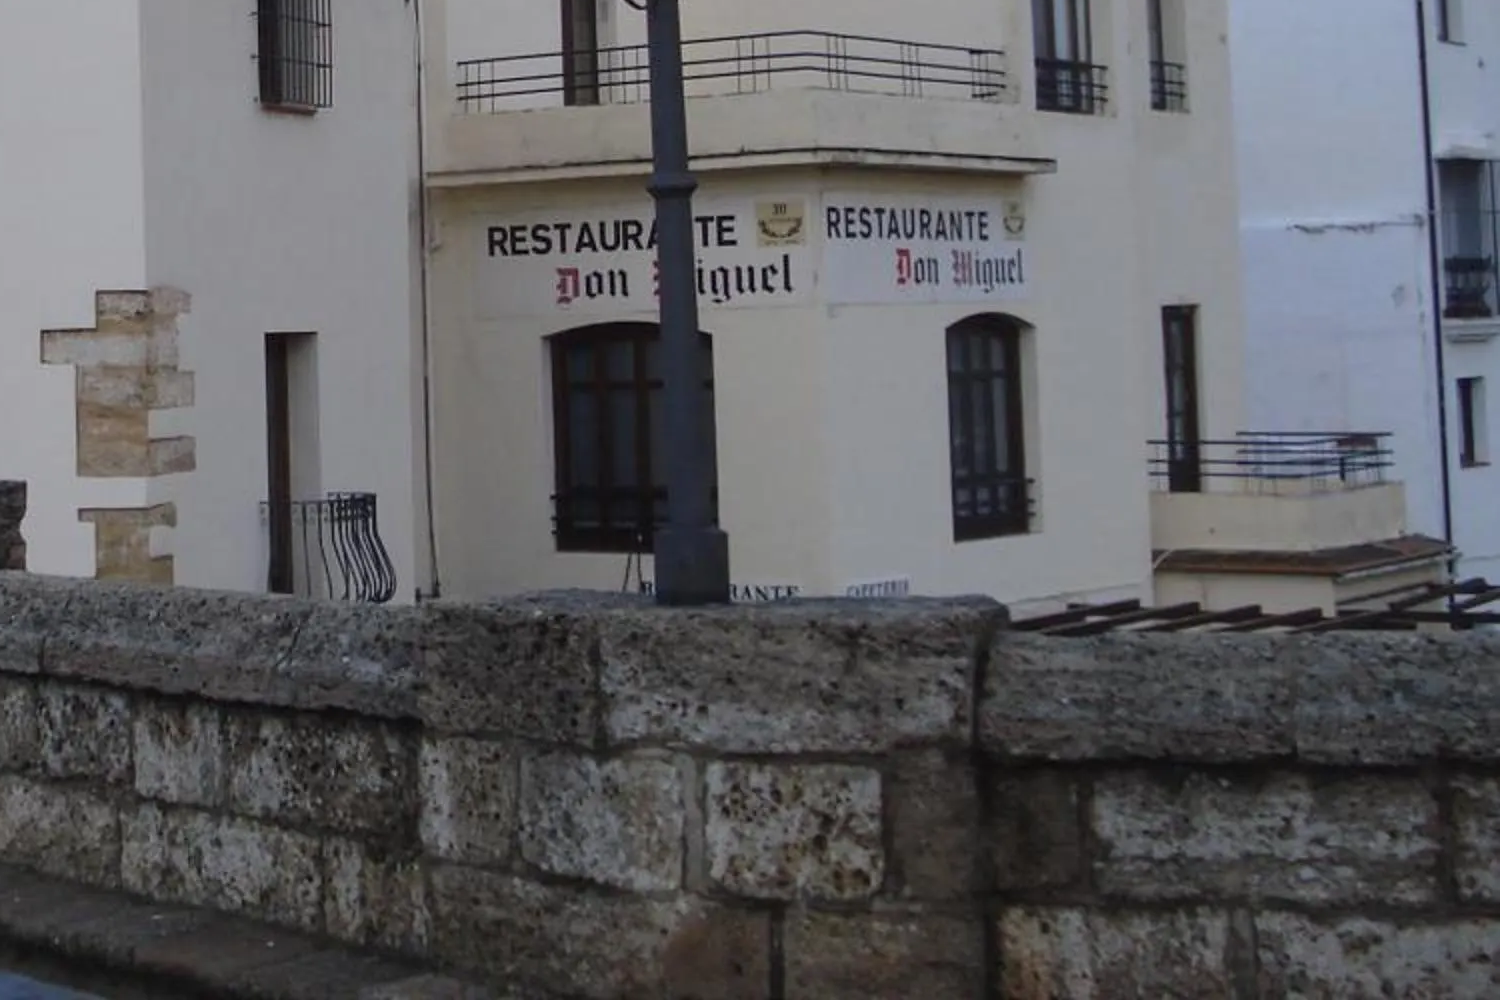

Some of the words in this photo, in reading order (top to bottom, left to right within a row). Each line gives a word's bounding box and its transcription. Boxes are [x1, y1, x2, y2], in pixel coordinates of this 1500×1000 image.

[487, 215, 737, 256] RESTAURATE
[826, 206, 990, 241] RESTAURANTE
[556, 267, 629, 304] Don
[653, 254, 793, 304] iguel
[896, 248, 940, 285] Don
[953, 247, 1025, 294] Miguel
